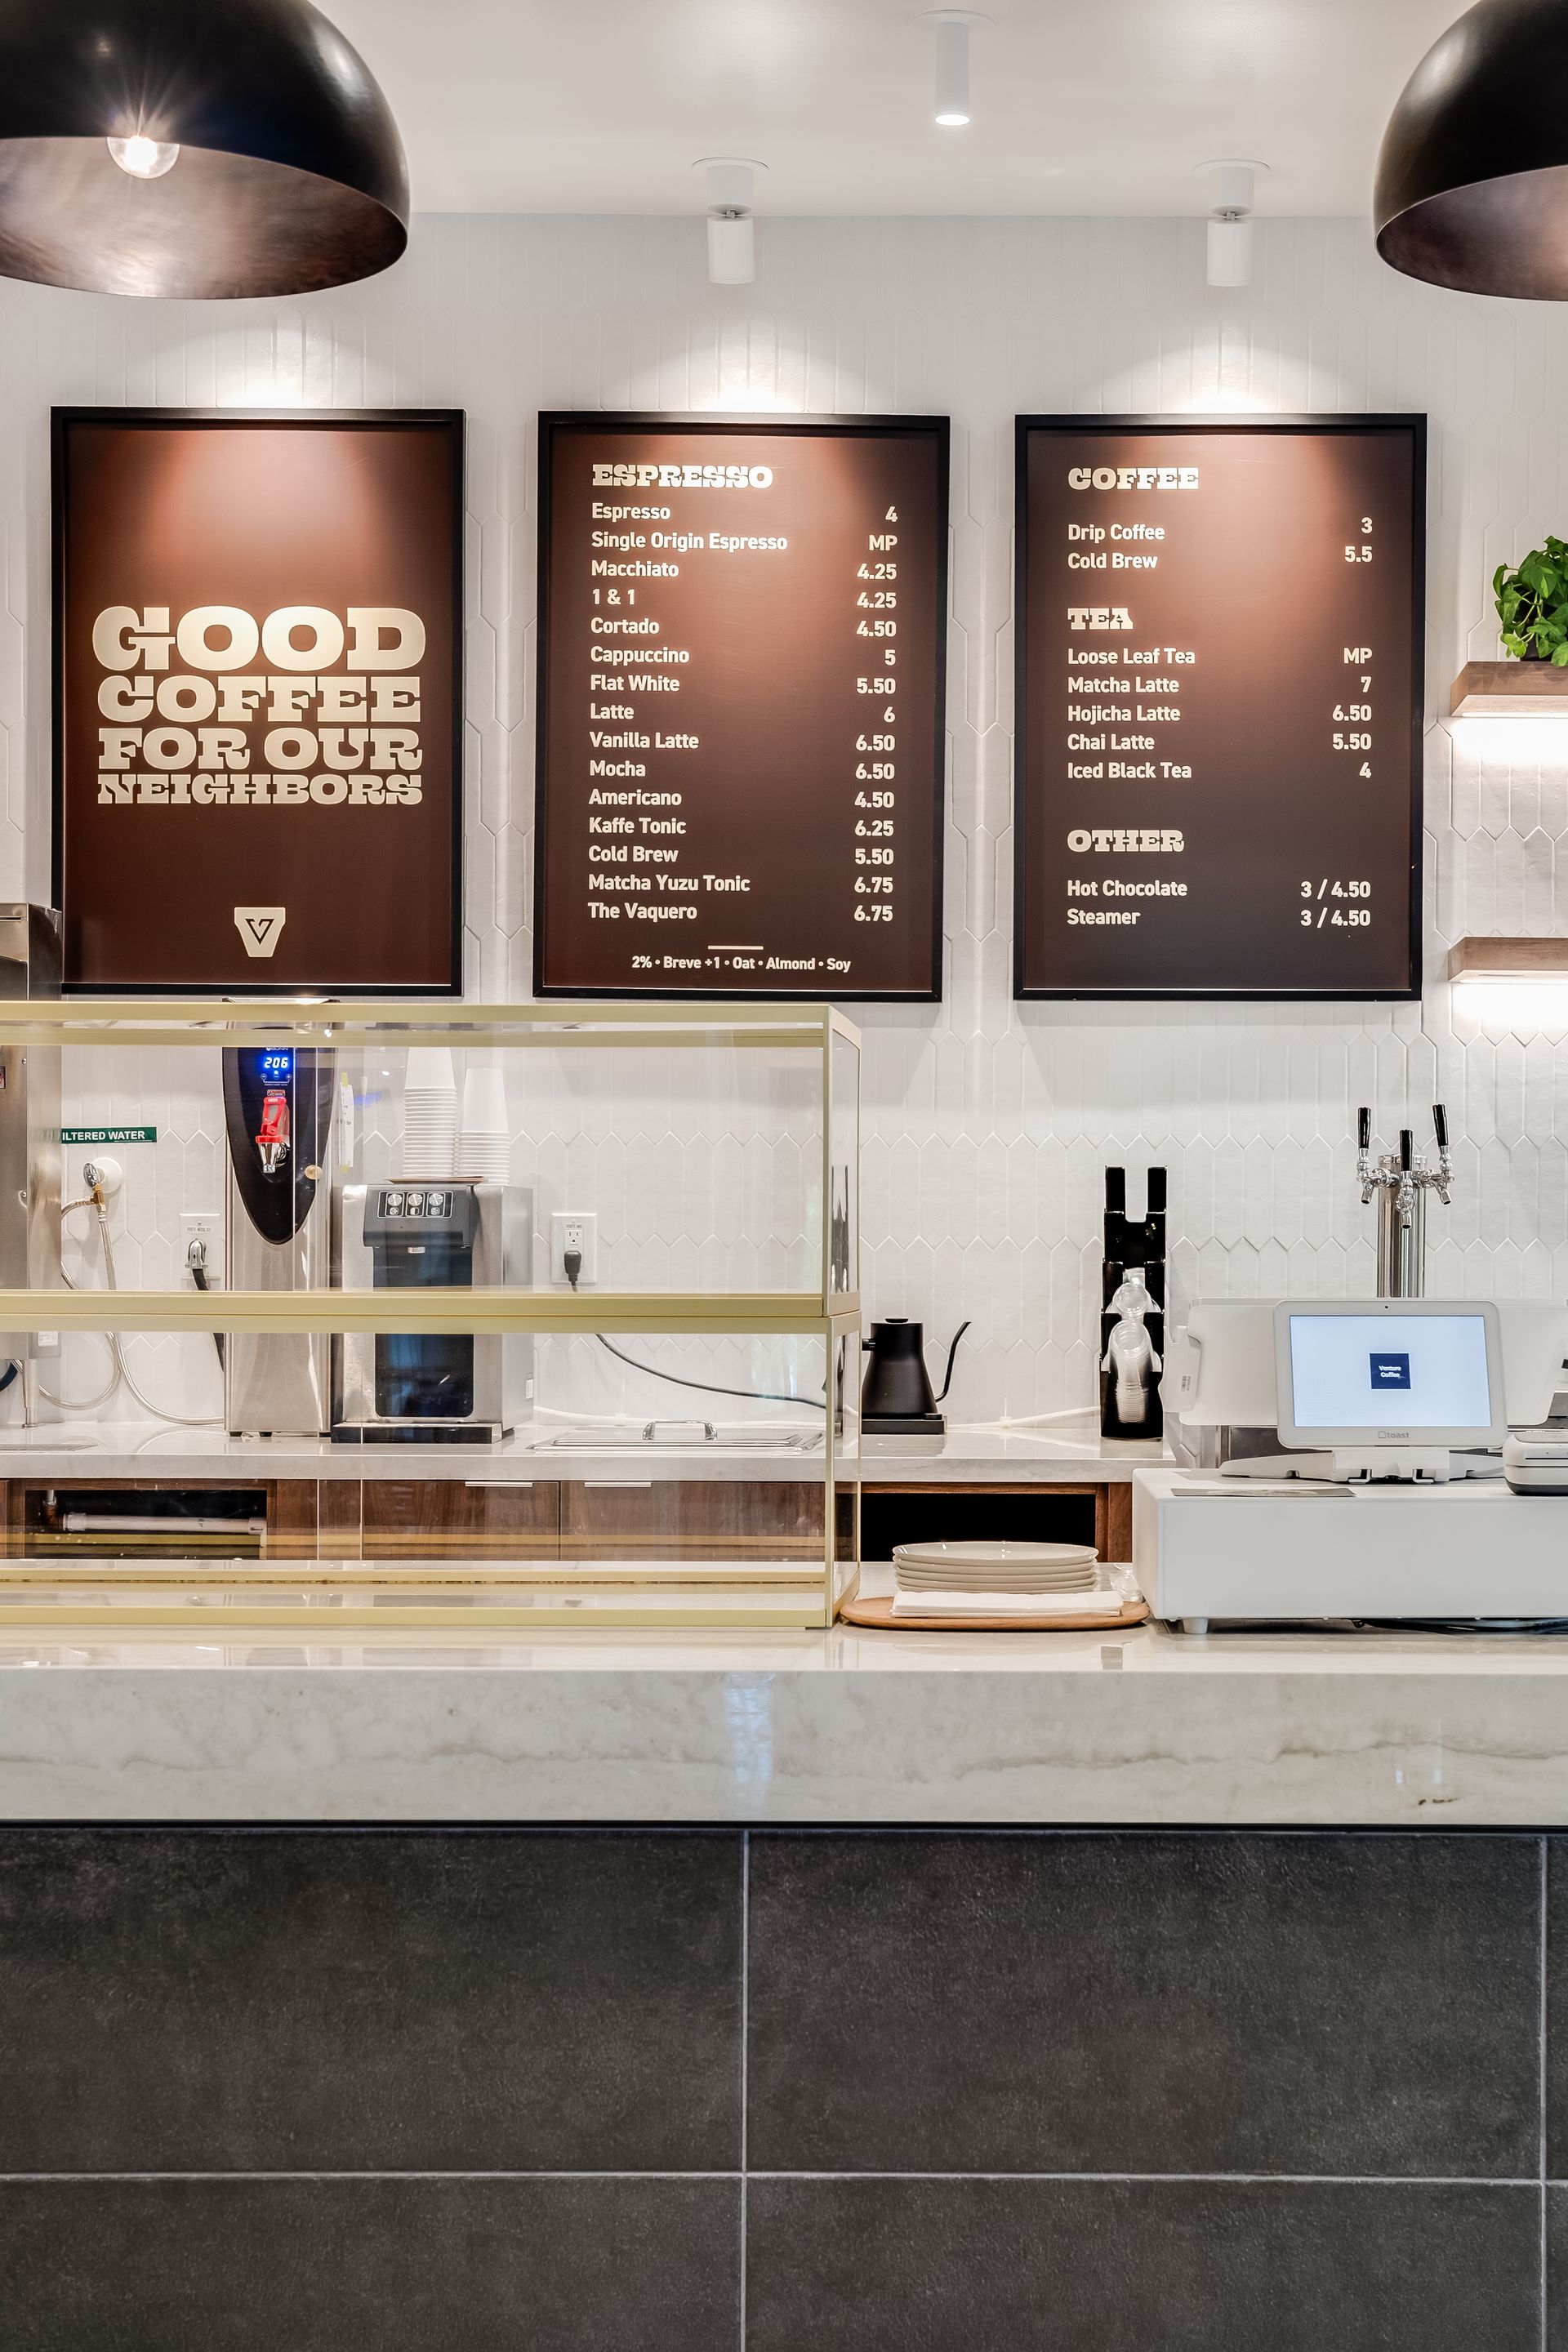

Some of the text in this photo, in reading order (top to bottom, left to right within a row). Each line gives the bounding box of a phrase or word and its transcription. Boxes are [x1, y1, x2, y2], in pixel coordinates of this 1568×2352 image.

[593, 464, 773, 489] ESPRESSO
[1068, 467, 1200, 490] COFFEE
[592, 502, 670, 521] Espresso
[885, 506, 898, 522] 4
[1068, 523, 1165, 543] Drip Coffee
[1361, 517, 1373, 534] 3
[591, 531, 787, 552] Single Origin Espresso
[868, 534, 898, 551] MP
[1068, 552, 1158, 569] Cold Brew
[1344, 546, 1373, 563] 5.5
[591, 560, 679, 577] Macchiato
[857, 564, 897, 580] 4.25
[592, 589, 635, 605] 1 & 1
[857, 592, 897, 608] 4.25
[591, 617, 660, 635] Cortado
[1067, 608, 1134, 630] TEA
[856, 621, 897, 637] 4.50
[92, 605, 425, 671] GOOD
[590, 646, 689, 666] Cappuccino
[884, 649, 896, 666] 5
[1068, 648, 1196, 665] Loose Leaf Tea
[1343, 648, 1373, 664] MP
[590, 675, 679, 692] Flat White
[857, 678, 897, 695] 5.50
[1068, 676, 1179, 693] Matcha Latte
[1361, 676, 1371, 693] 7
[98, 675, 421, 723] COFFEE
[590, 703, 635, 719] Latte
[883, 706, 895, 723] 6
[1067, 704, 1181, 724] Hojicha Latte
[1332, 705, 1372, 722] 6.50
[99, 728, 422, 770] FOR OUR
[590, 732, 699, 749] Vanilla Latte
[855, 735, 895, 751] 6.50
[1067, 733, 1155, 751] Chai Latte
[1332, 733, 1372, 751] 5.50
[590, 760, 646, 777] Mocha
[855, 763, 895, 780] 6.50
[1067, 762, 1192, 778] Iced Black Tea
[1359, 762, 1372, 778] 4
[99, 774, 422, 805] NEIGHBORS
[589, 789, 682, 806] Americano
[854, 791, 895, 808] 4.50
[589, 817, 686, 835] Kaffe Tonic
[854, 820, 894, 837] 6.25
[1067, 830, 1184, 852] OTHER
[589, 846, 679, 862] Cold Brew
[854, 849, 894, 866] 5.50
[589, 875, 751, 892] Matcha Yuzu Tonic
[853, 877, 893, 893] 6.75
[1067, 880, 1187, 897] Hot Chocolate
[1300, 879, 1371, 899] 3 / 4.50
[588, 902, 697, 922] The Vaquero
[853, 906, 893, 922] 6.75
[1067, 908, 1141, 925] Steamer
[1300, 907, 1371, 928] 3 / 4.50
[631, 956, 851, 972] 2% Breve +1 Oat Almond Soy
[264, 1057, 288, 1068] 206
[62, 1130, 145, 1141] ILTERED WATER
